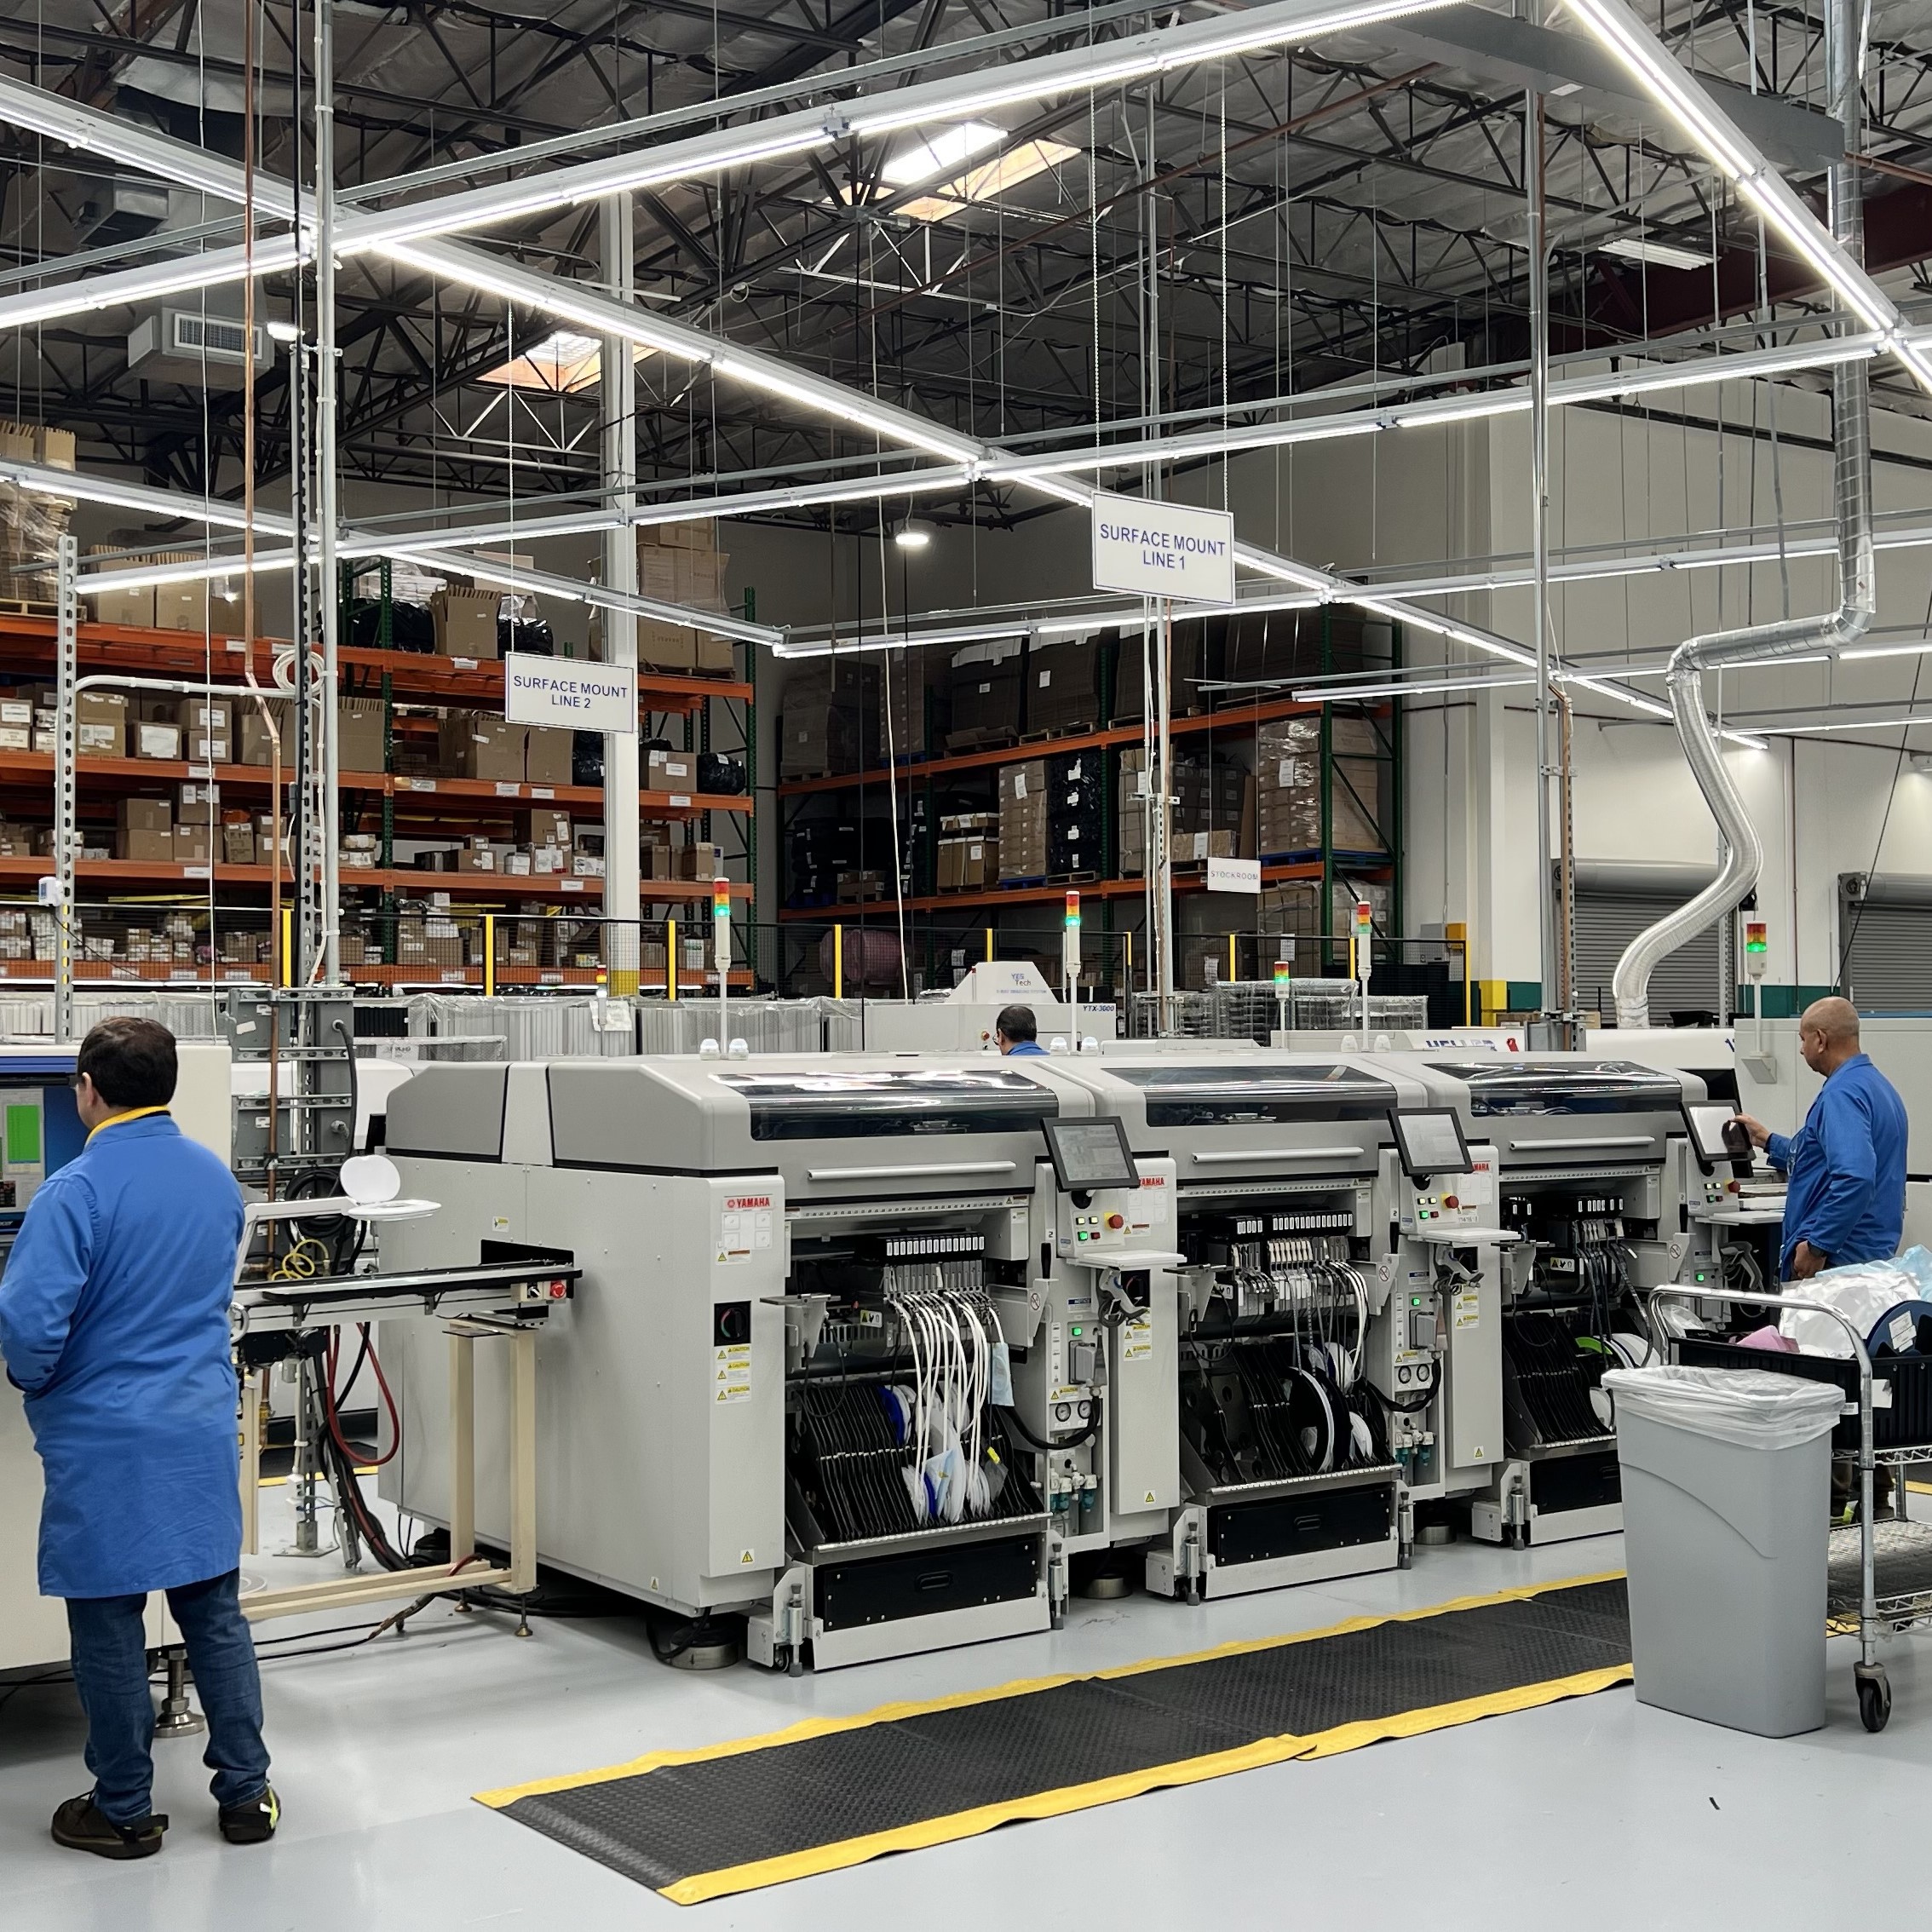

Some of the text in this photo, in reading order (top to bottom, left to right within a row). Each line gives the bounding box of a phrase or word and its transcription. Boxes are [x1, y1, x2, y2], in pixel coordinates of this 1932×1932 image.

[1100, 523, 1226, 556] SURFACE MOUNT
[1142, 549, 1186, 570] LINE 1
[514, 676, 628, 699] SURFACE MOUNT
[551, 694, 591, 709] LINE 2
[1210, 870, 1258, 880] STOCKROOM
[736, 1197, 770, 1209] YAMAHA
